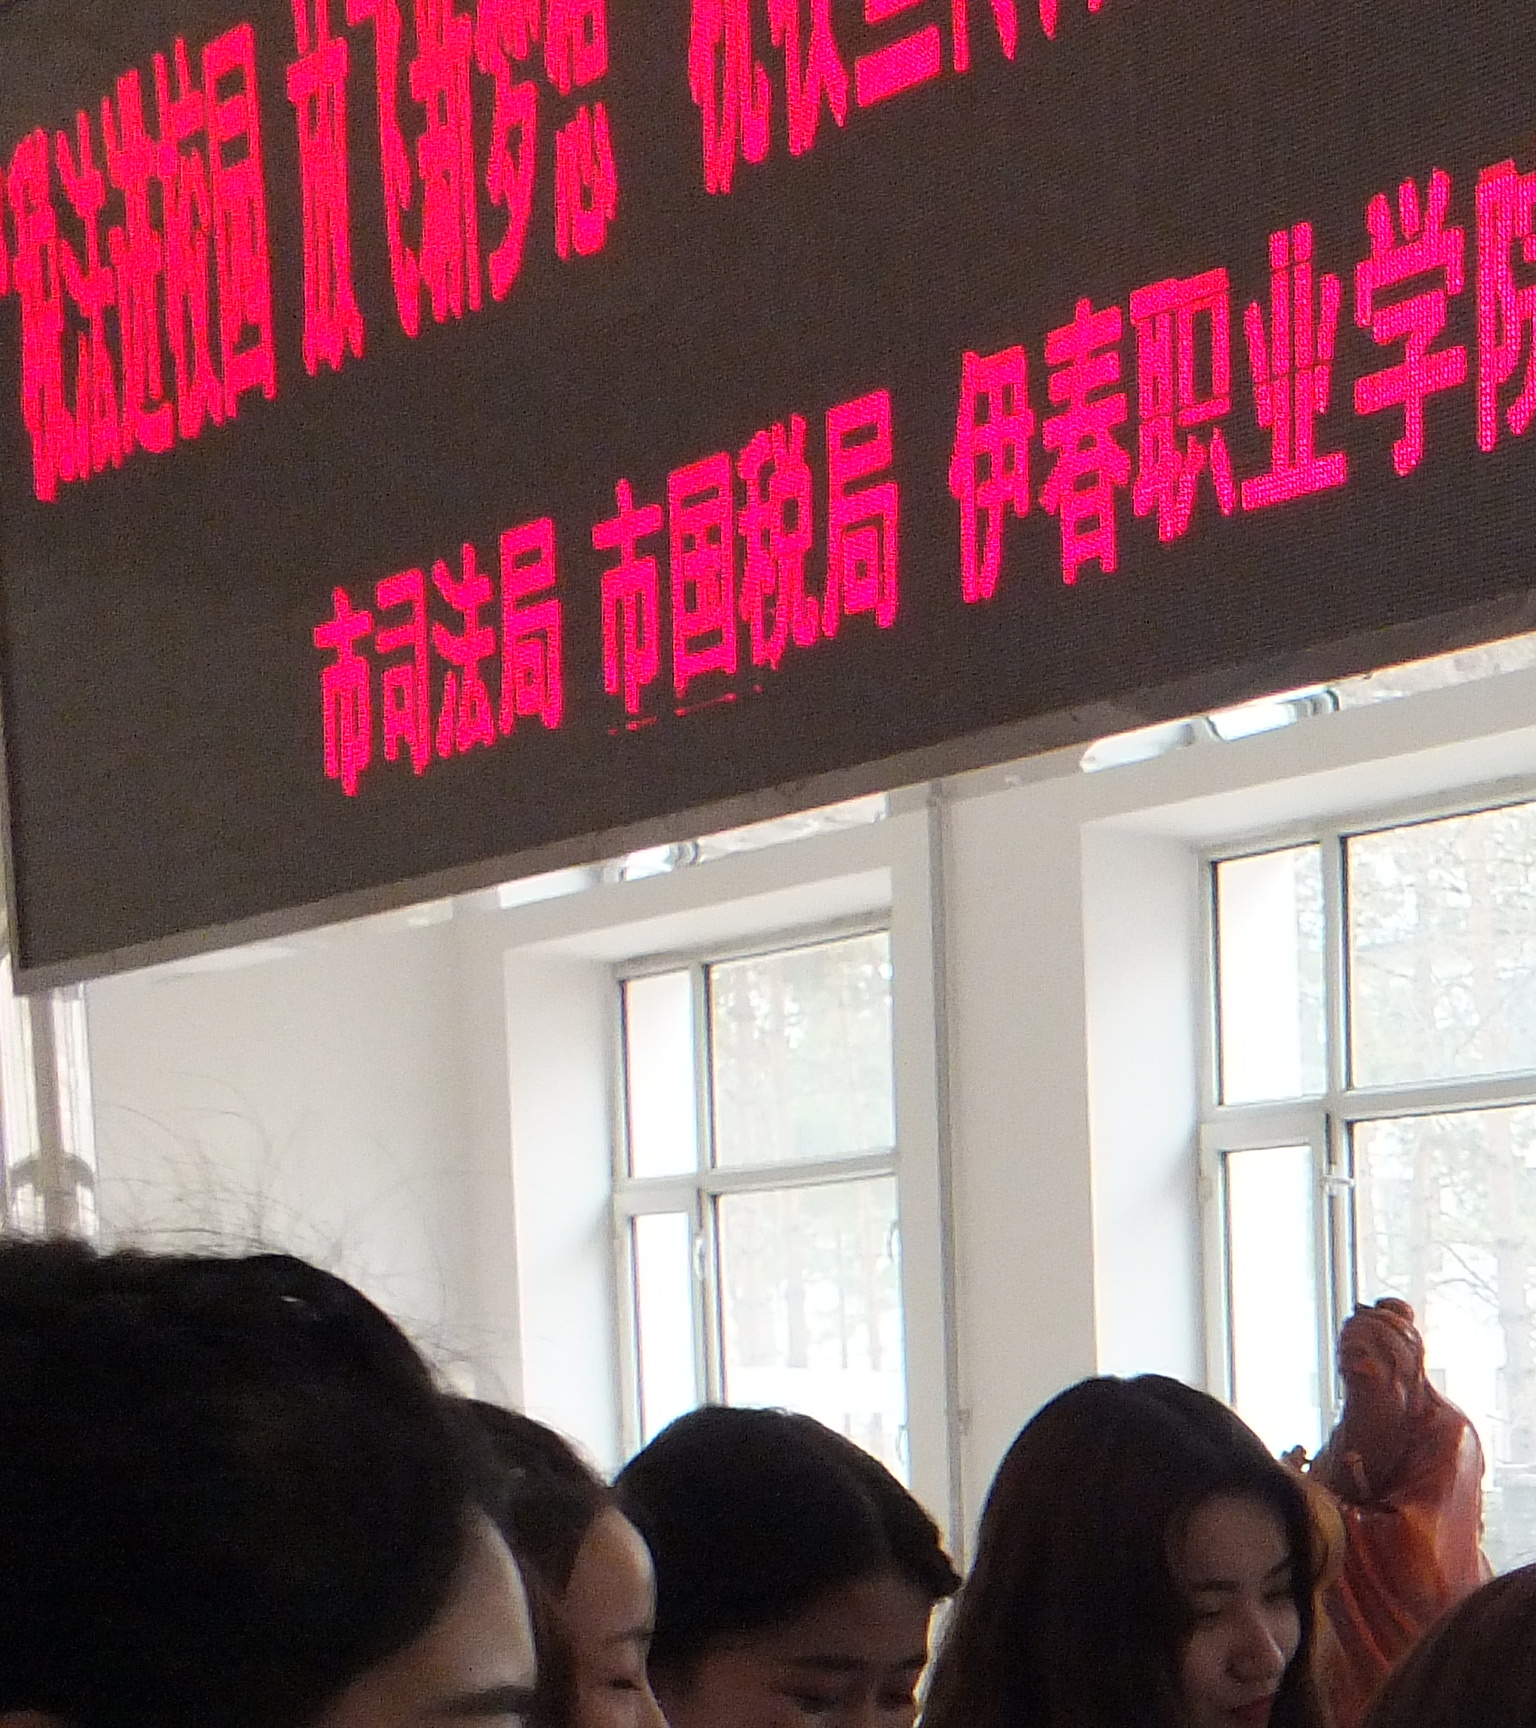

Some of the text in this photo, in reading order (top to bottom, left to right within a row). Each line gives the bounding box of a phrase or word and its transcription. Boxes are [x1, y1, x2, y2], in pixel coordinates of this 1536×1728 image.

[0, 24, 276, 502] 税法进校园
[313, 516, 563, 797] 市司法局
[592, 388, 900, 715] 市国税局
